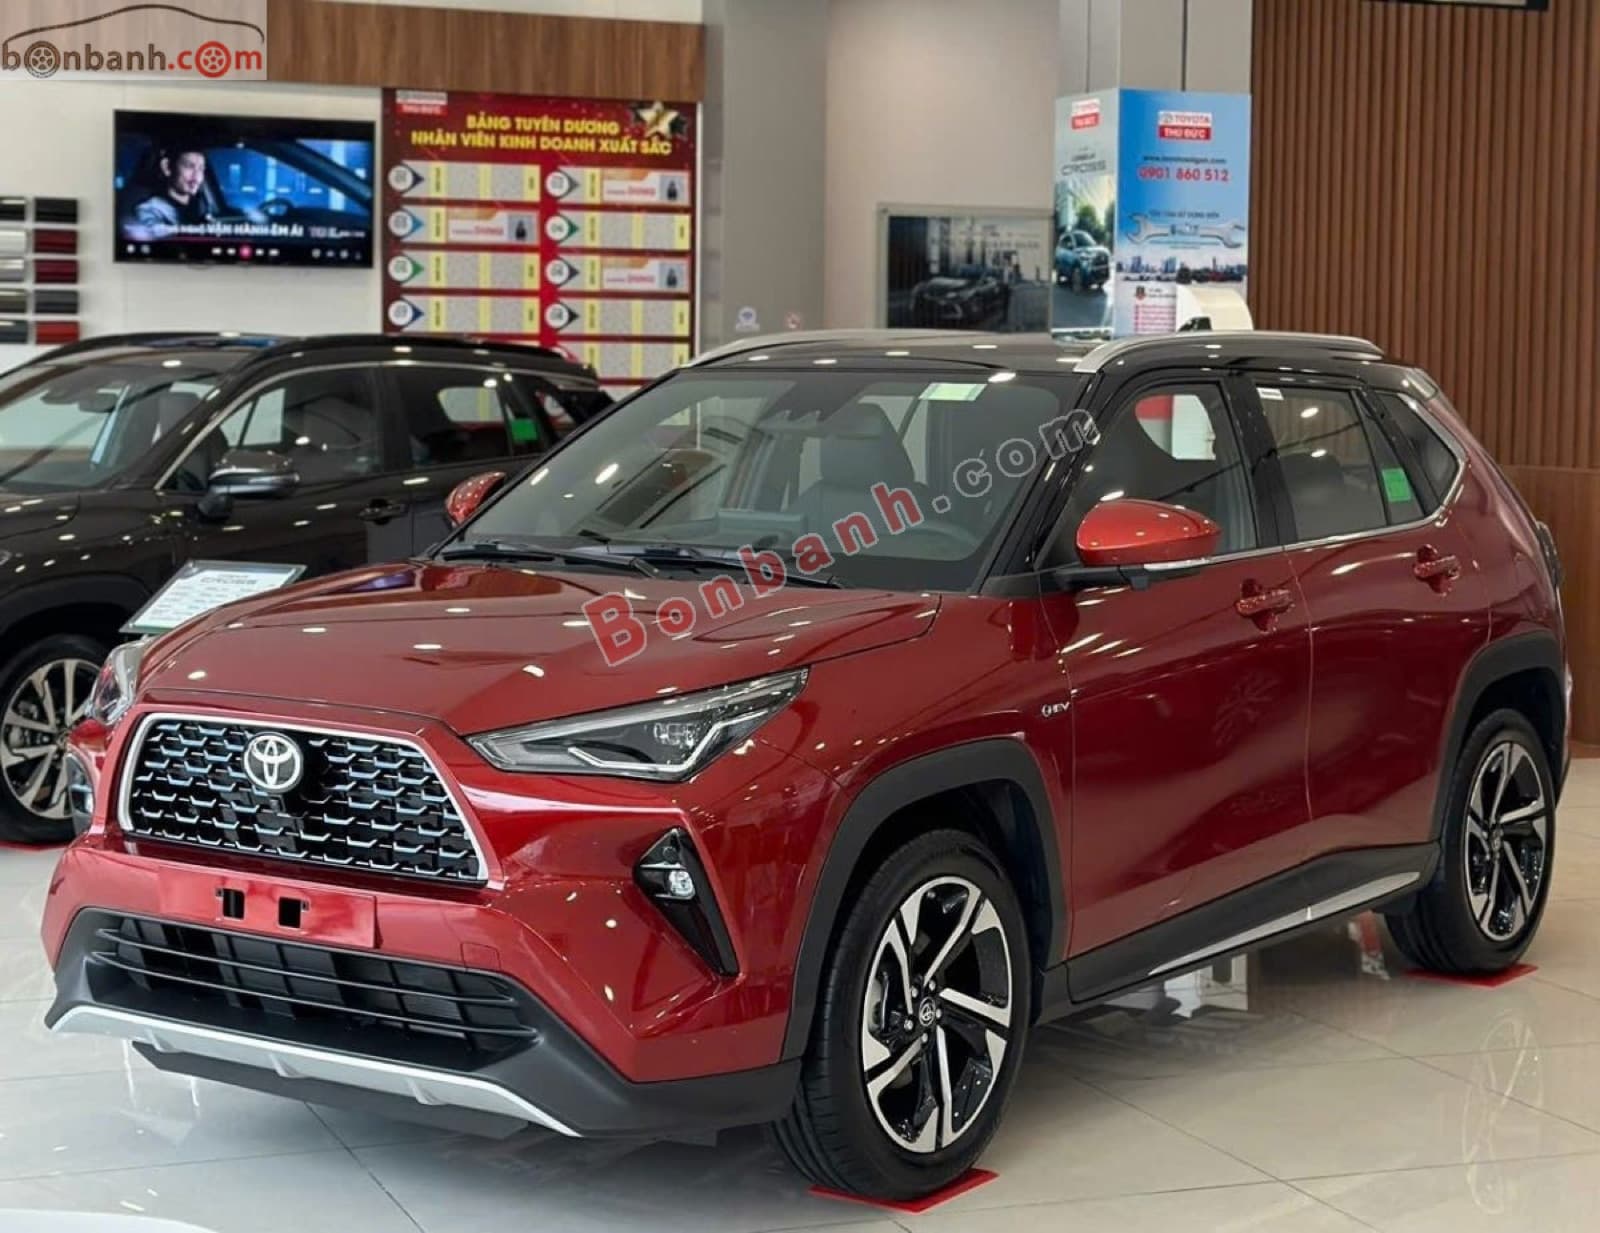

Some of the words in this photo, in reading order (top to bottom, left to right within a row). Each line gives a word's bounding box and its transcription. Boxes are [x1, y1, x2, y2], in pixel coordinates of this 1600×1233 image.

[466, 111, 512, 130] BẢNG
[515, 116, 561, 133] TUYÊN
[563, 117, 620, 135] DƯƠNG
[411, 128, 457, 146] NHÂN
[460, 131, 496, 148] VIÊN
[500, 134, 537, 149] KINH
[540, 136, 595, 152] DOANH
[599, 135, 638, 153] XUẤT
[639, 136, 673, 156] SẮC
[1176, 167, 1200, 180] 860
[1204, 168, 1229, 182] 512
